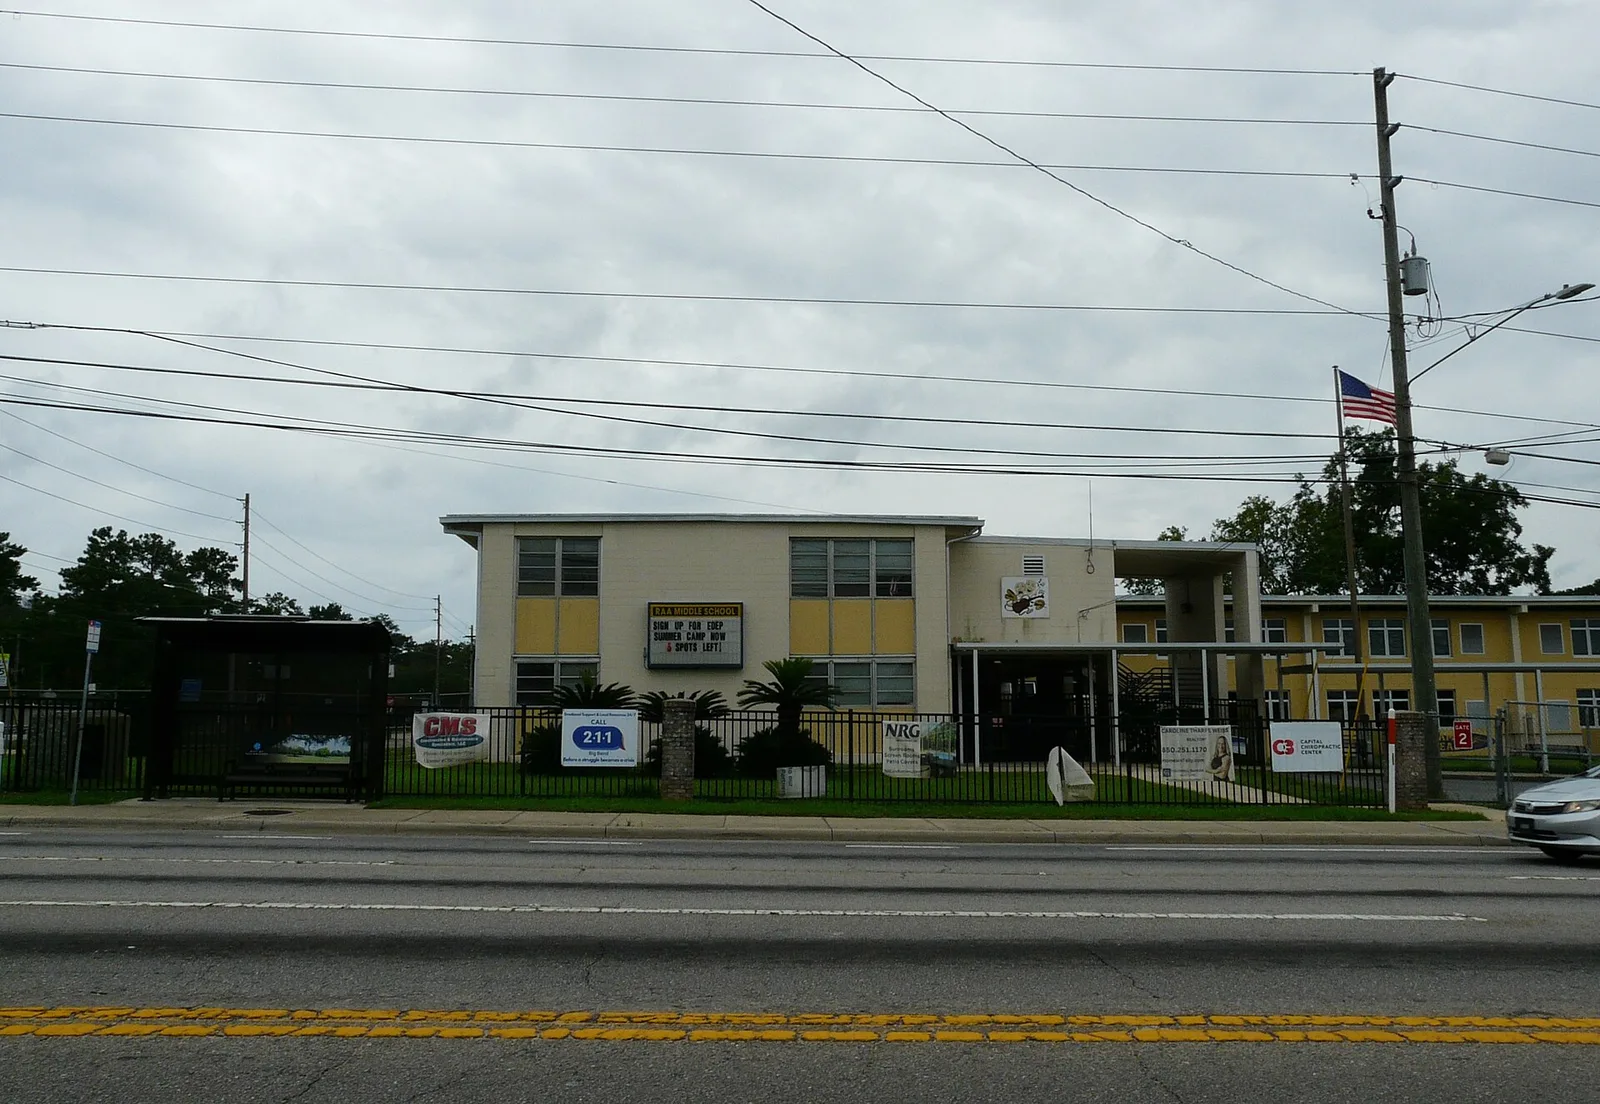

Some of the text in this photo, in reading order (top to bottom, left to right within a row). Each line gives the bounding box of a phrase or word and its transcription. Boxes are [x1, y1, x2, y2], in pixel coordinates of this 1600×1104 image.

[655, 607, 736, 615] RAA MIDDLE SCHOOL
[652, 621, 669, 630] SIGN
[674, 621, 684, 630] UP
[688, 621, 702, 630] FOR
[654, 632, 726, 641] SUMMER CAMP NOW
[675, 642, 698, 652] SPOTS
[424, 716, 477, 737] CMS
[885, 724, 920, 739] NRG
[1459, 733, 1467, 745] 2
